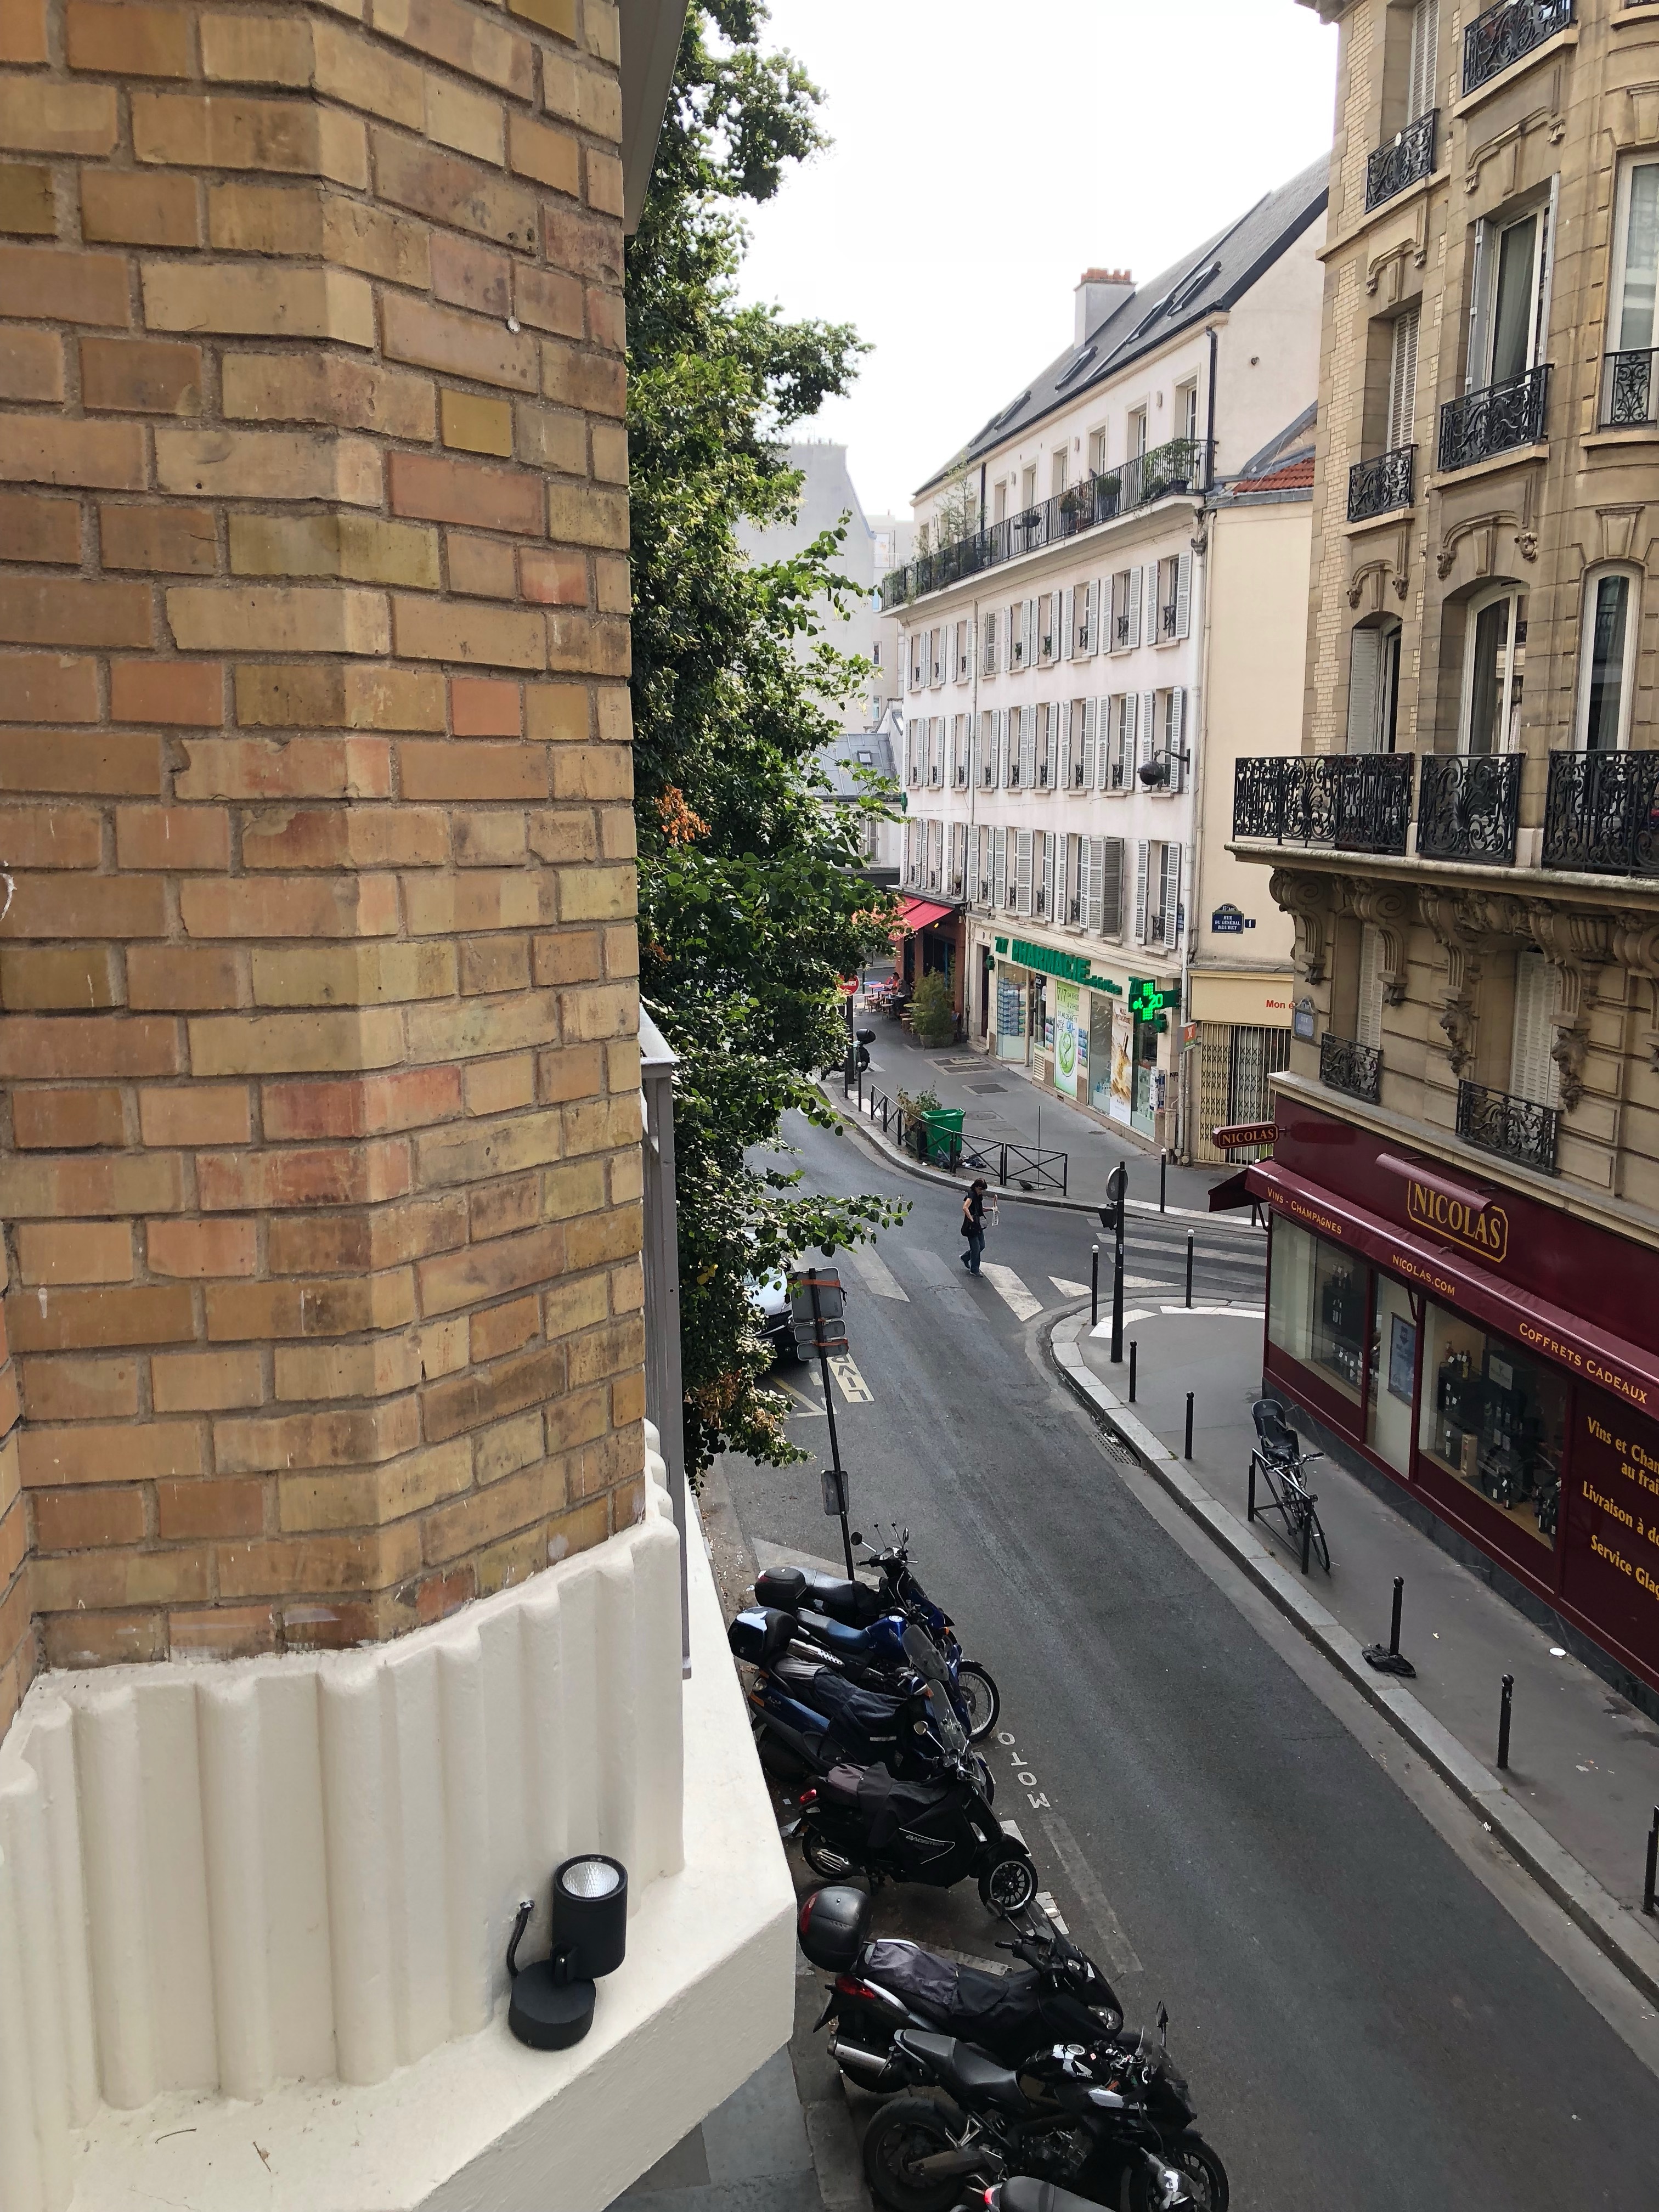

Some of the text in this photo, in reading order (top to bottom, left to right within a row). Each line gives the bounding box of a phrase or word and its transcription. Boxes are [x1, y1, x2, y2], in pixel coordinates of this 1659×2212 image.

[1012, 939, 1091, 985] PHARMACIE
[1149, 994, 1163, 1009] 20
[1266, 1000, 1285, 1008] Mon
[1222, 1129, 1274, 1144] NICOLAS
[1413, 1183, 1500, 1249] NICOLAS
[1393, 1255, 1455, 1296] NICOLAS.COM
[1520, 1323, 1647, 1404] COFFRETS CADEAUX
[1588, 1416, 1612, 1444] Vins
[1616, 1438, 1627, 1454] et
[1621, 1463, 1635, 1480] au
[1583, 1481, 1633, 1527] Livraison
[1637, 1517, 1644, 1535] à
[1591, 1535, 1632, 1576] Service
[997, 1732, 1051, 1808] MOTO
